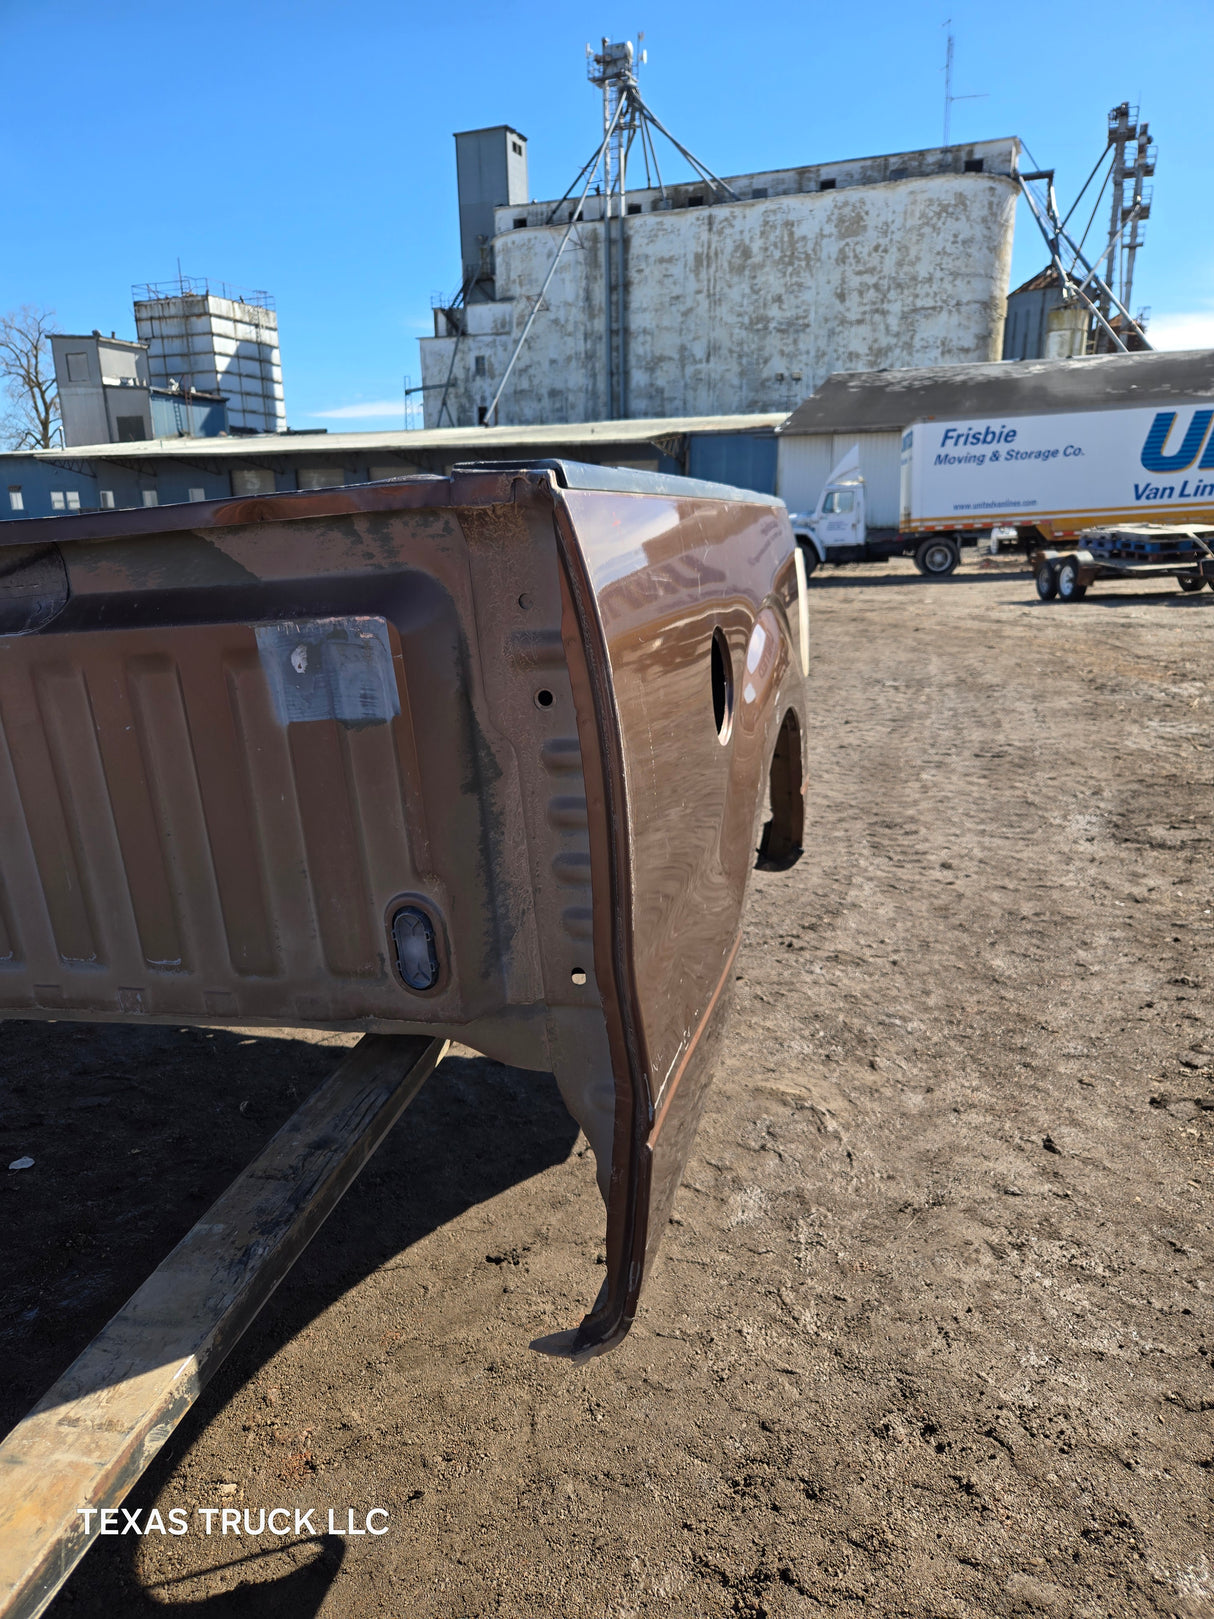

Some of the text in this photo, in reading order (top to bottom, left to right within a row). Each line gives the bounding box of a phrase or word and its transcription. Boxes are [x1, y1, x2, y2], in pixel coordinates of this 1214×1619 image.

[940, 425, 1017, 448] Frisbie
[934, 445, 1085, 466] Moving & Storage Co.
[1134, 482, 1175, 500] Van
[953, 498, 1037, 511] www.unitedvanlines.com
